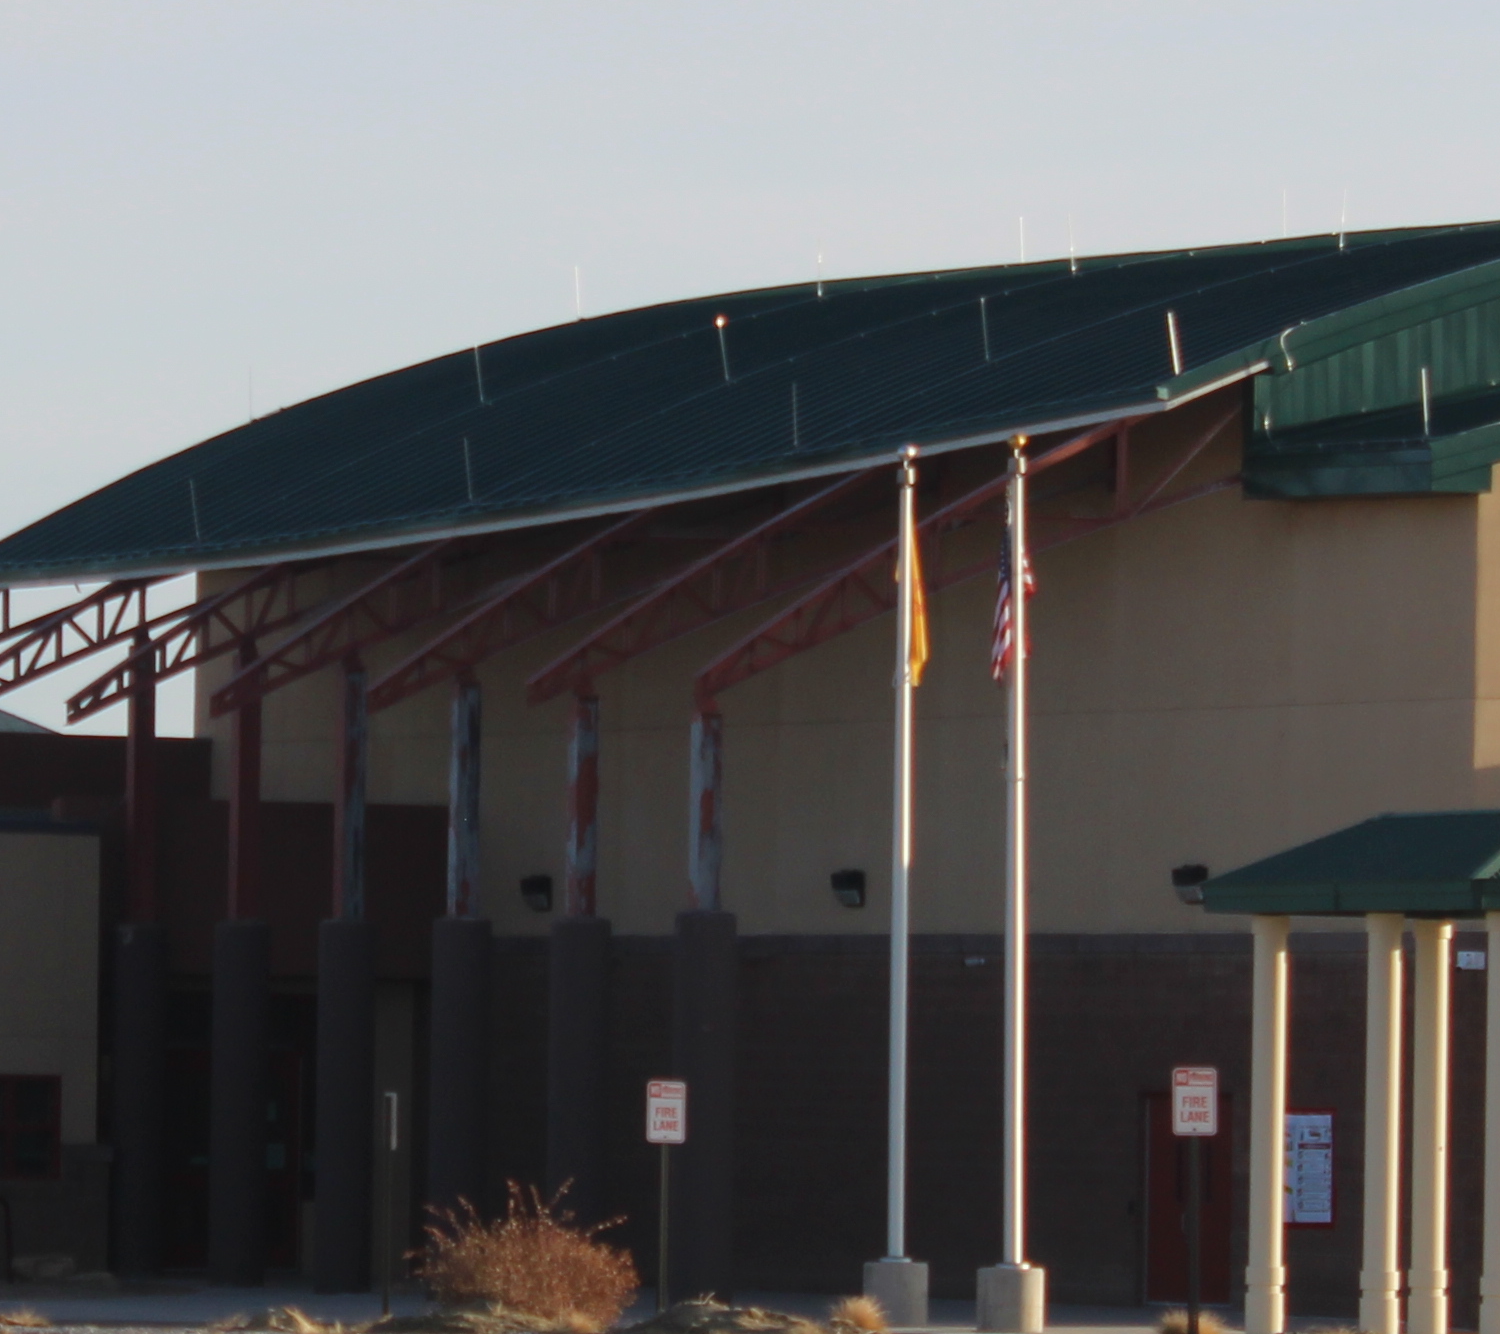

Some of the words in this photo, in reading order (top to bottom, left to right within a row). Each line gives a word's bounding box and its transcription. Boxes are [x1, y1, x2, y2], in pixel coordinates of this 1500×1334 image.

[1182, 1096, 1207, 1108] FIRE
[655, 1107, 678, 1118] FIRE
[1180, 1111, 1209, 1123] LANE
[653, 1120, 679, 1131] LANE
